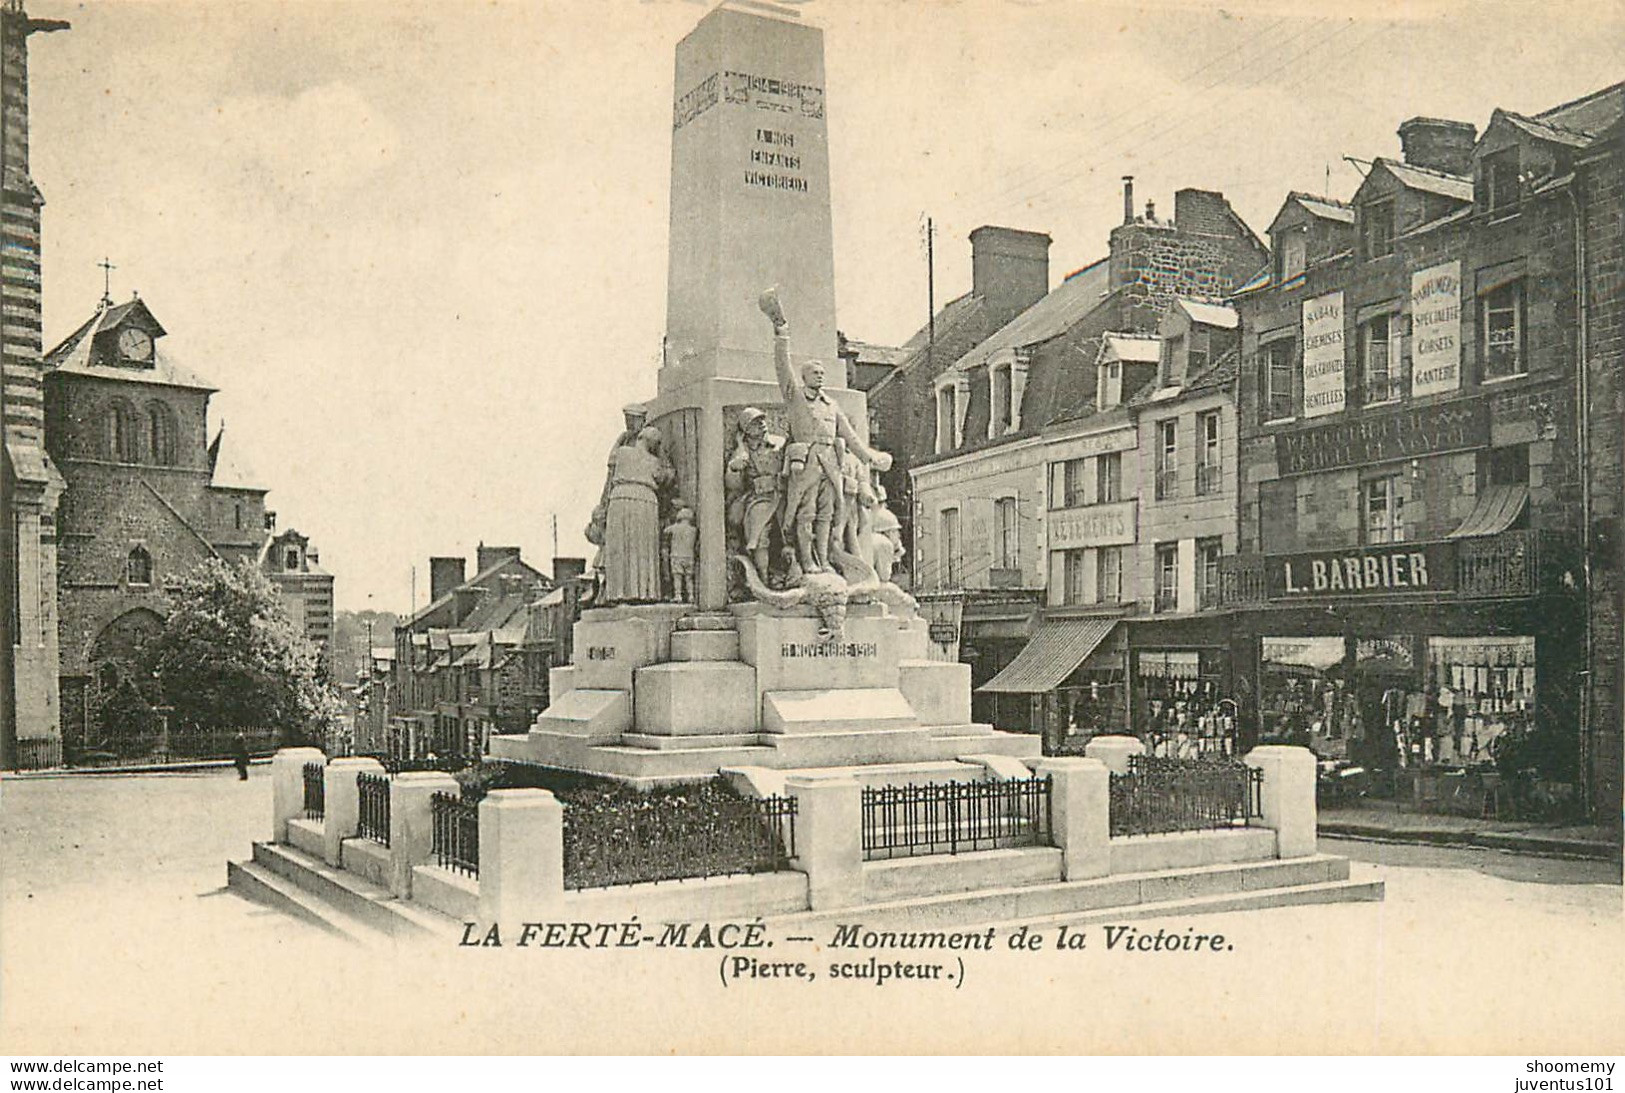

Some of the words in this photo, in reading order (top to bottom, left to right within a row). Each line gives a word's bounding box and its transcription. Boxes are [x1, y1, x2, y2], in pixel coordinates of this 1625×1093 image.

[772, 130, 795, 147] NOS
[751, 150, 801, 169] ENFANTS
[744, 170, 808, 192] VICTORIEUX
[1306, 329, 1344, 351] CHEMISES
[1418, 336, 1455, 355] CORSETS
[1305, 389, 1345, 409] DENTELLES
[1285, 563, 1308, 593] L.
[1312, 552, 1428, 591] BARBIER
[460, 922, 502, 948] LA
[517, 915, 776, 948] FERTÉ-MACÉ.
[828, 925, 994, 950] Monument
[1008, 925, 1044, 950] de
[1056, 925, 1088, 950] la
[1104, 923, 1236, 951] Victoire.
[719, 955, 817, 987] (Pierre,
[828, 955, 966, 988] sculpteur.)
